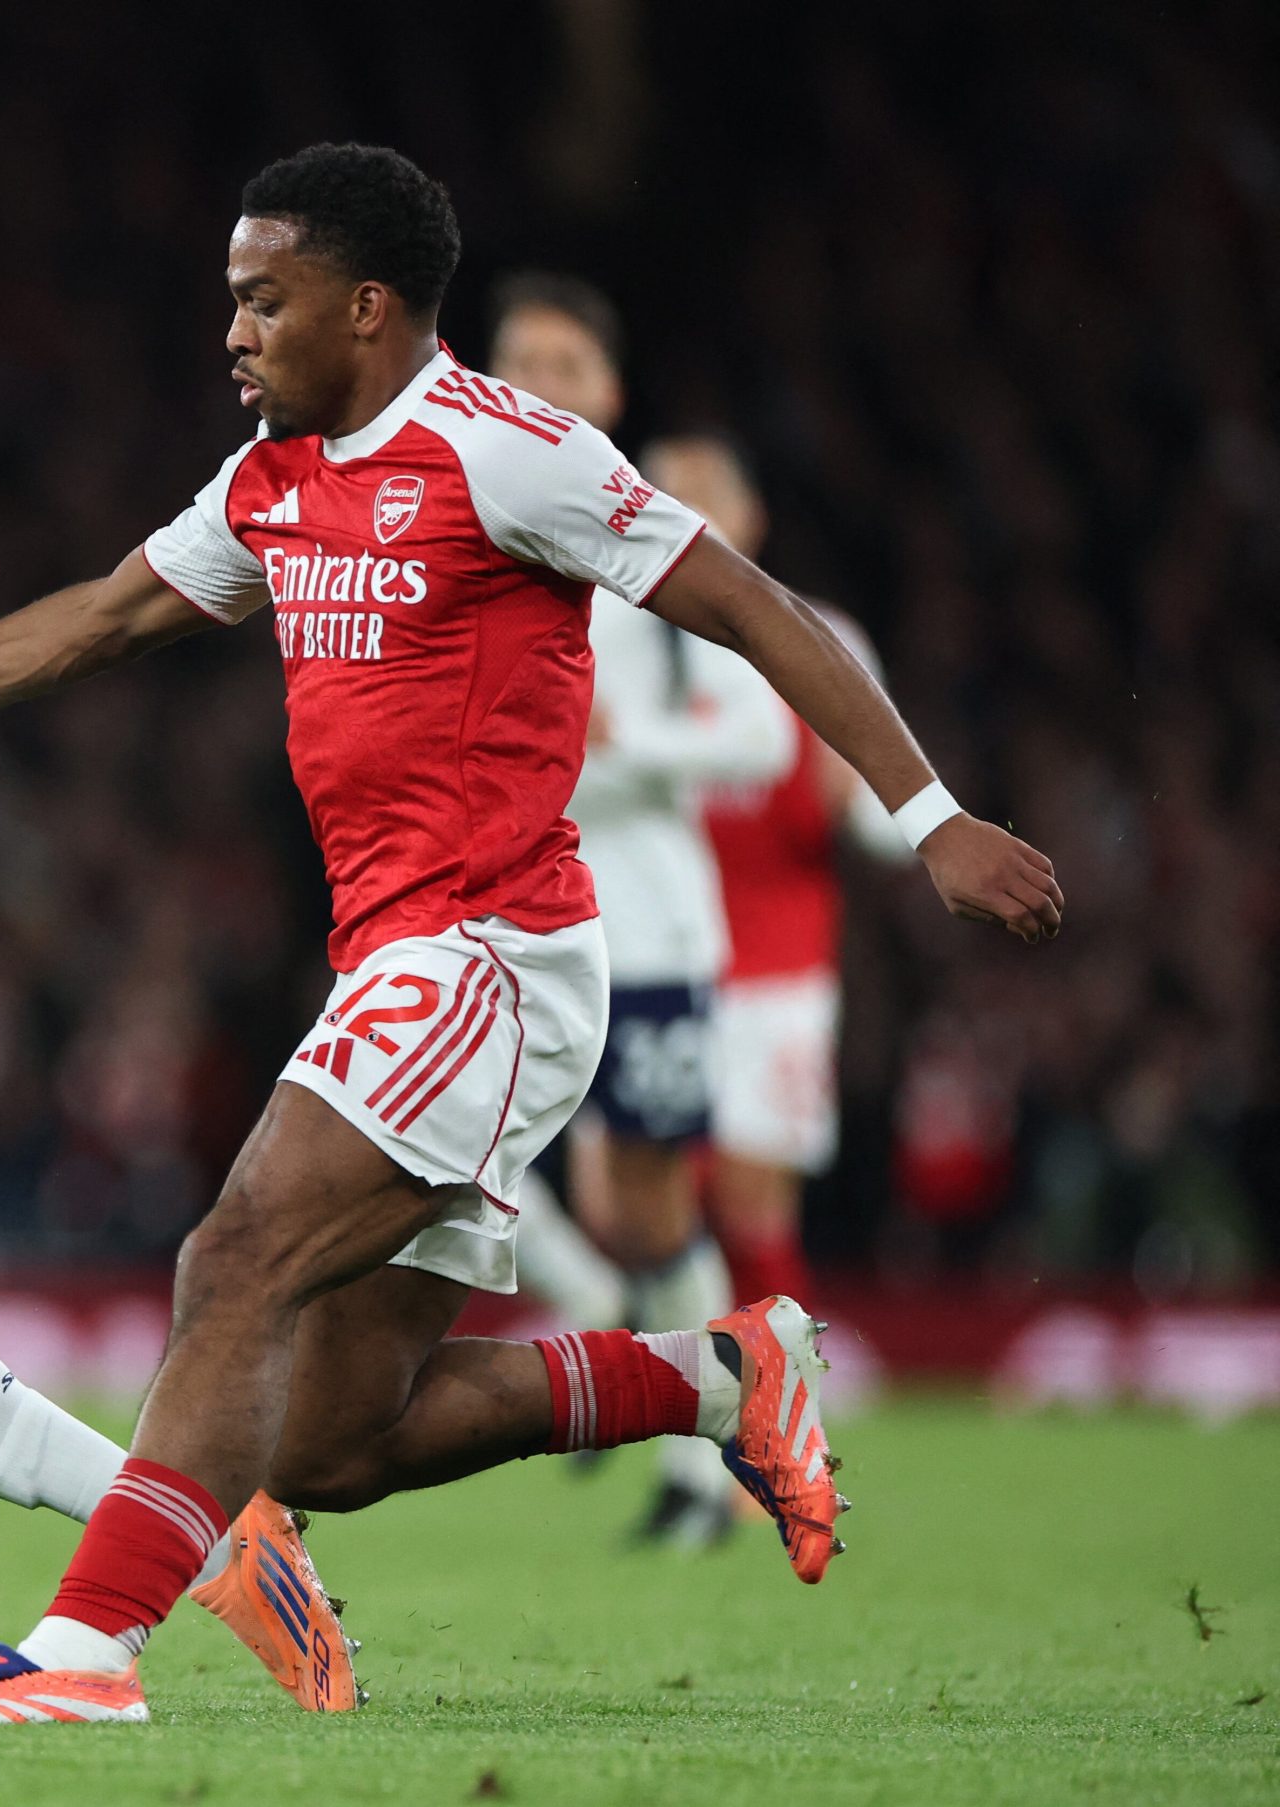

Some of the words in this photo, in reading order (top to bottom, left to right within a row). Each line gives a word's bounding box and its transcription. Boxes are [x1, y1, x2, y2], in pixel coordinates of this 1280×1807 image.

[383, 486, 418, 498] Arsenal
[601, 465, 634, 495] VIS
[607, 480, 656, 535] RWA
[263, 542, 428, 605] Emirates
[302, 612, 384, 660] BETTER
[323, 972, 441, 1058] 12
